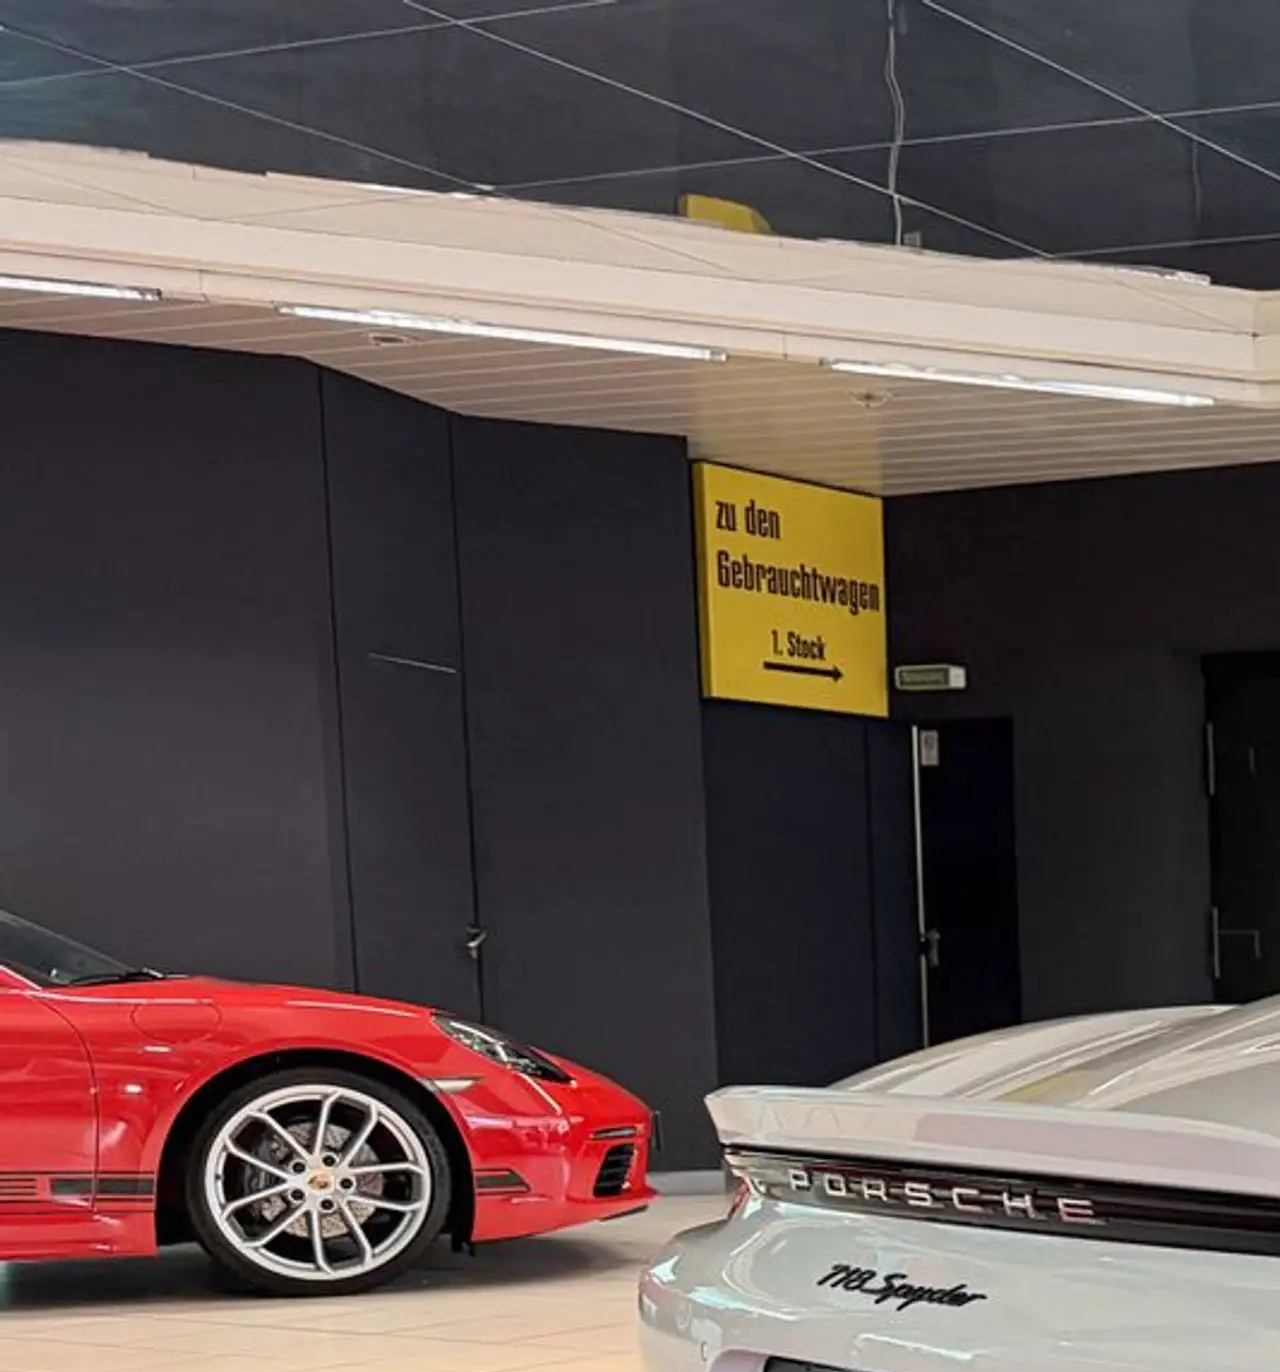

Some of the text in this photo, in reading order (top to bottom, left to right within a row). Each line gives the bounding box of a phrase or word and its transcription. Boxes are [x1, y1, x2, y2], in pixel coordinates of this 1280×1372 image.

[715, 499, 781, 539] zu den
[717, 550, 879, 615] Gebrauchtwagen
[771, 629, 826, 661] 1. Stock
[788, 1167, 1098, 1224] PORSCHE
[816, 1264, 987, 1311] 718 Spyder
